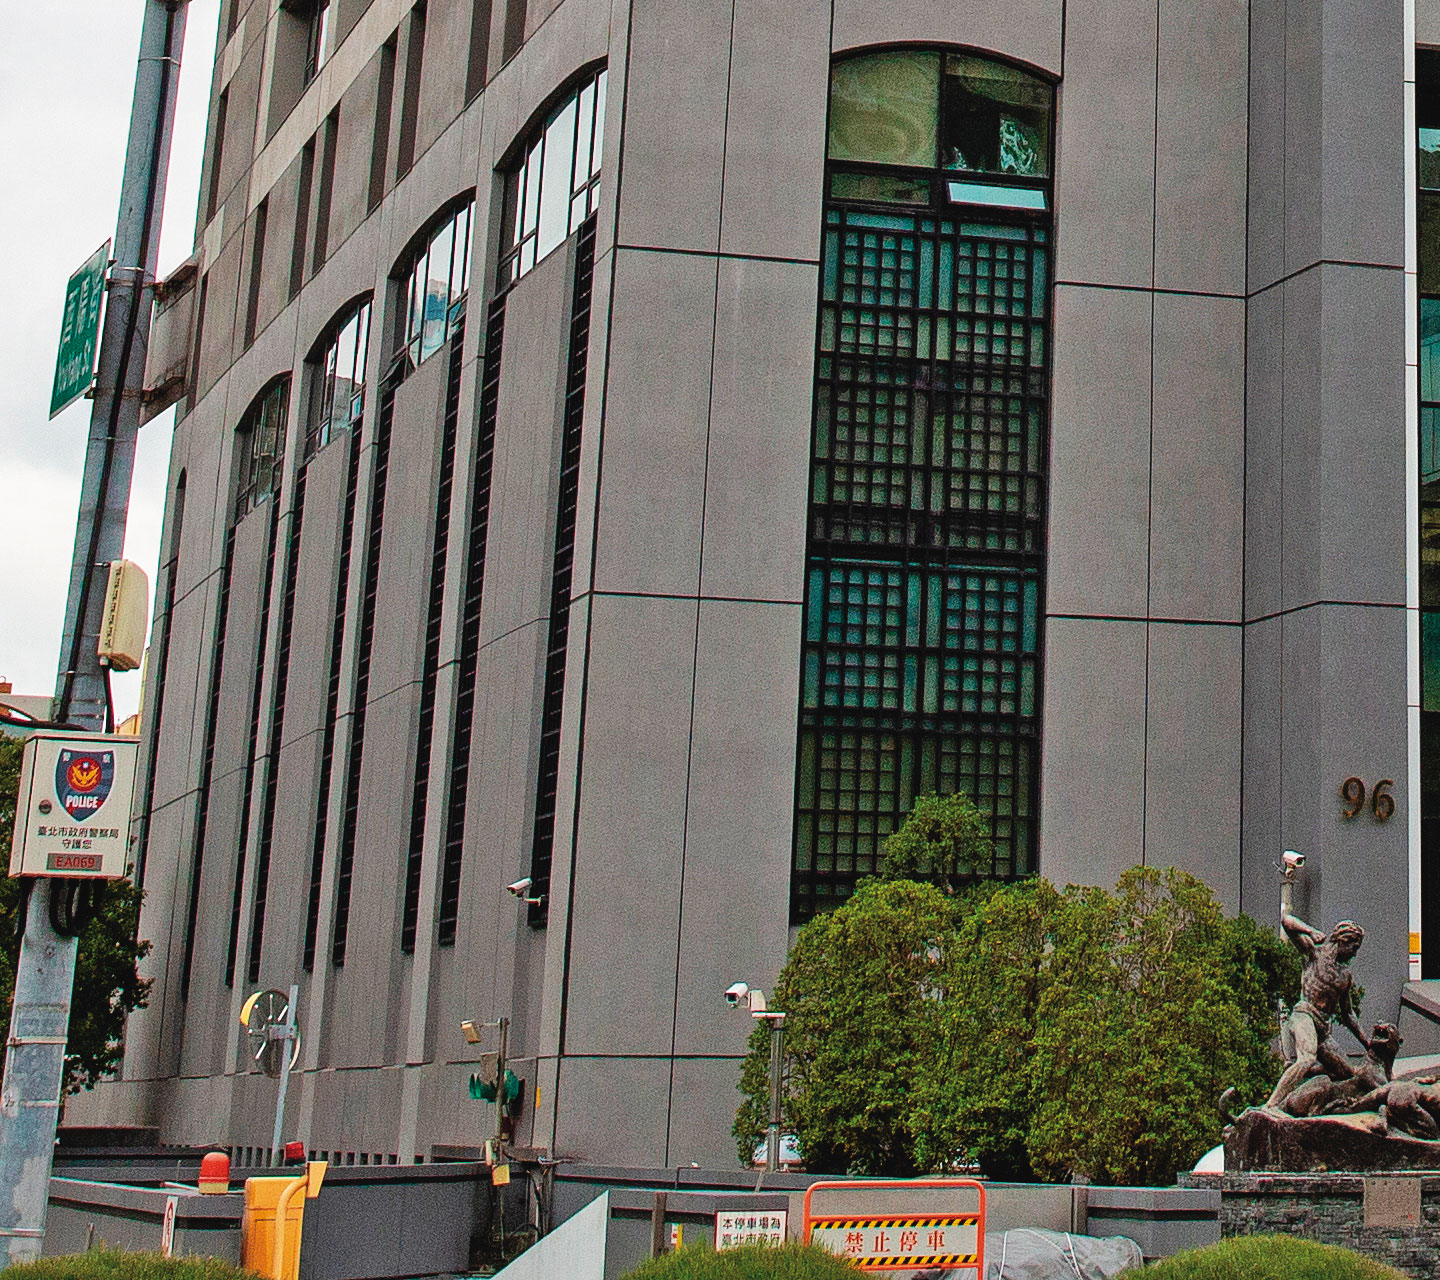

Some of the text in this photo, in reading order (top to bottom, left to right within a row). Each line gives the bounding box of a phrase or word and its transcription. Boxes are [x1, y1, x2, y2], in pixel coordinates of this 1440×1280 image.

[65, 794, 99, 809] POLICE
[1341, 776, 1396, 820] 96
[55, 855, 96, 869] EA069
[844, 1230, 945, 1253] 禁止停車
